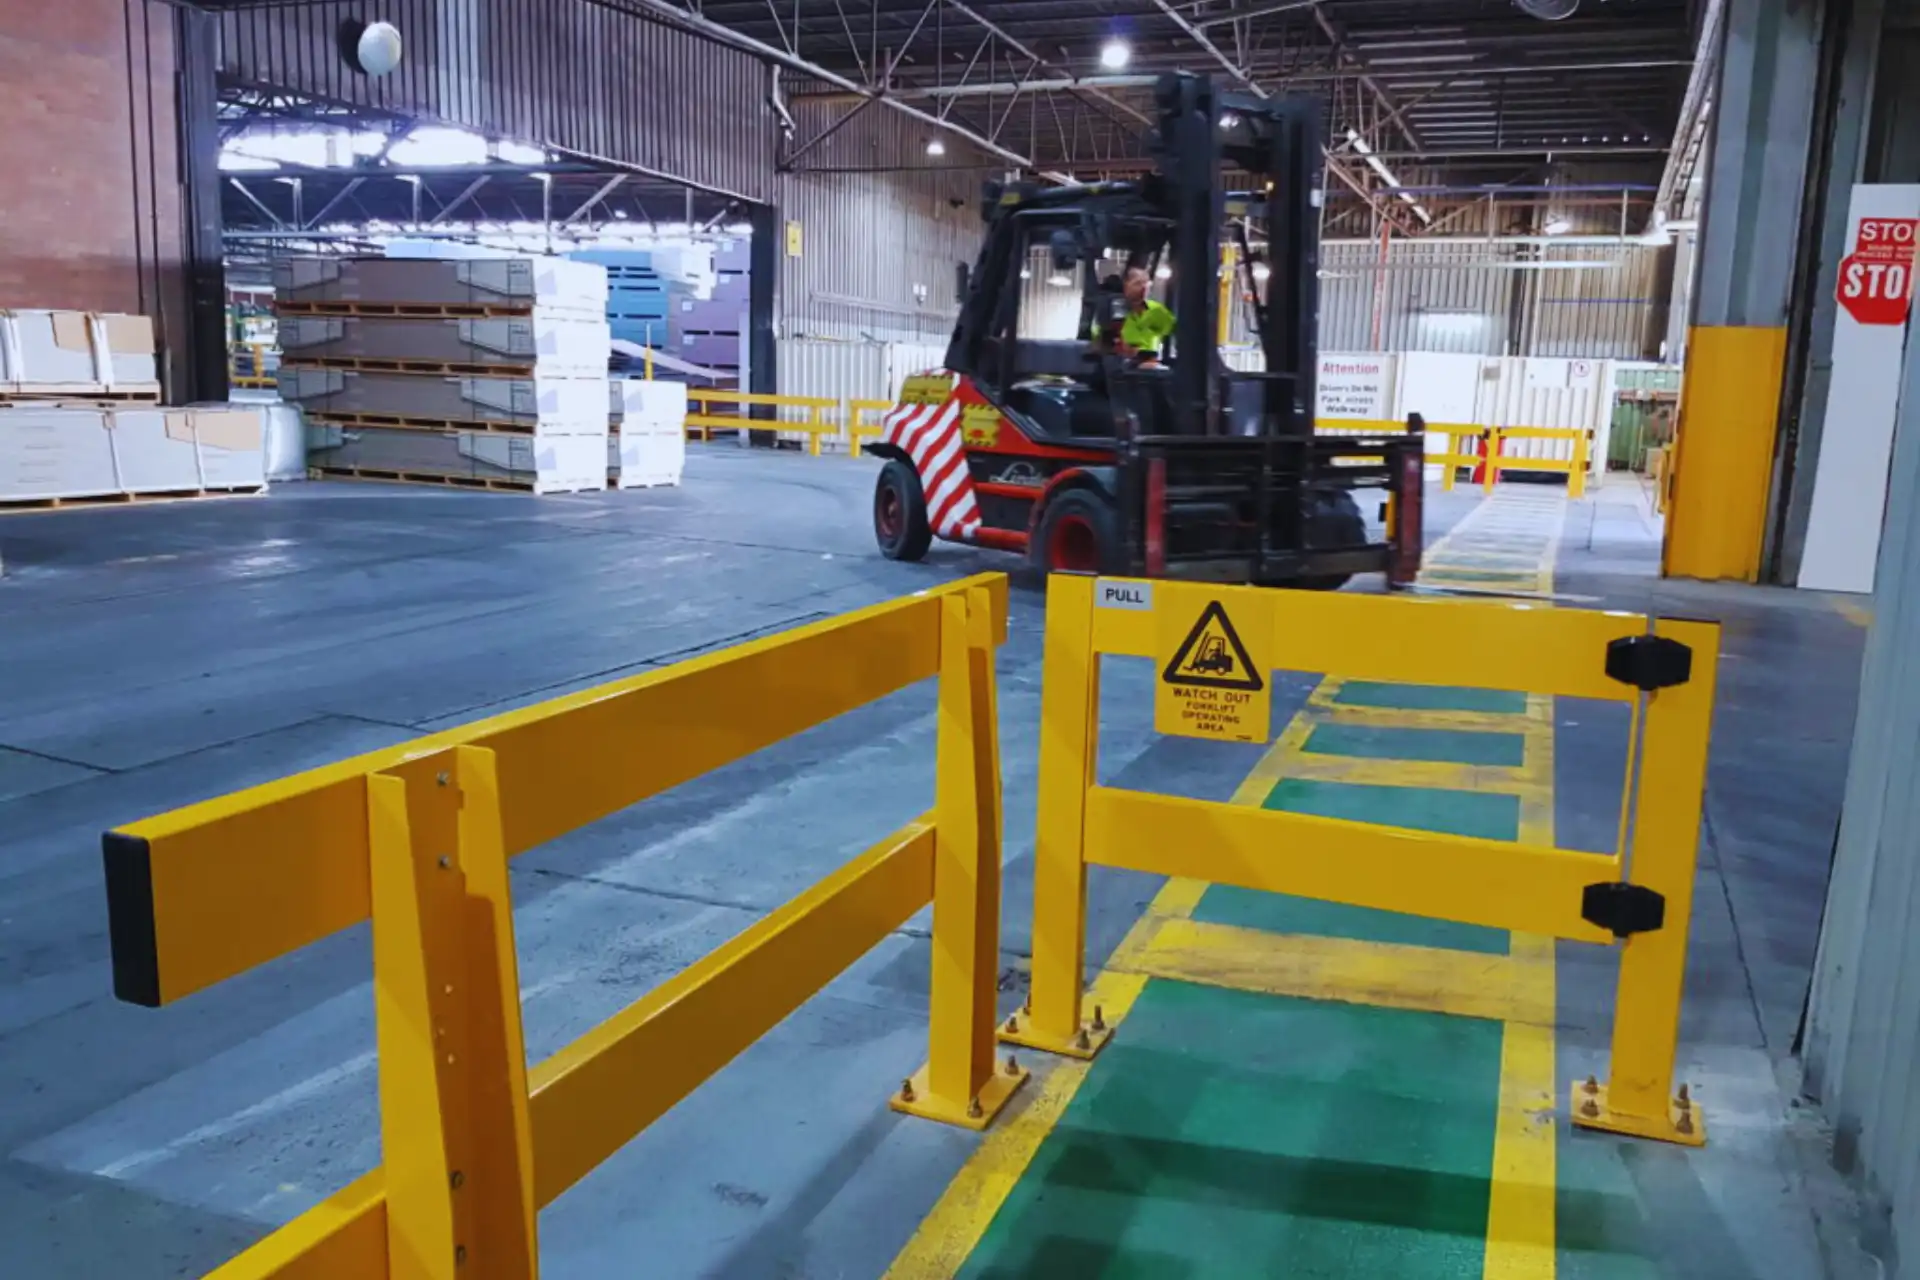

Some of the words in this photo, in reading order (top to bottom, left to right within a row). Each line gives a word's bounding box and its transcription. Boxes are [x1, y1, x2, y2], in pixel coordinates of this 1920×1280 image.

[1860, 221, 1912, 243] STO
[1843, 262, 1906, 300] STO
[1323, 362, 1379, 375] Attention
[1321, 395, 1340, 403] Park
[1105, 587, 1144, 604] PULL
[1172, 687, 1218, 701] WATCH
[1224, 692, 1251, 704] OUT
[1186, 701, 1236, 714] FORKLIFT
[1181, 710, 1241, 724] OPERATING
[1196, 722, 1225, 733] AREA
